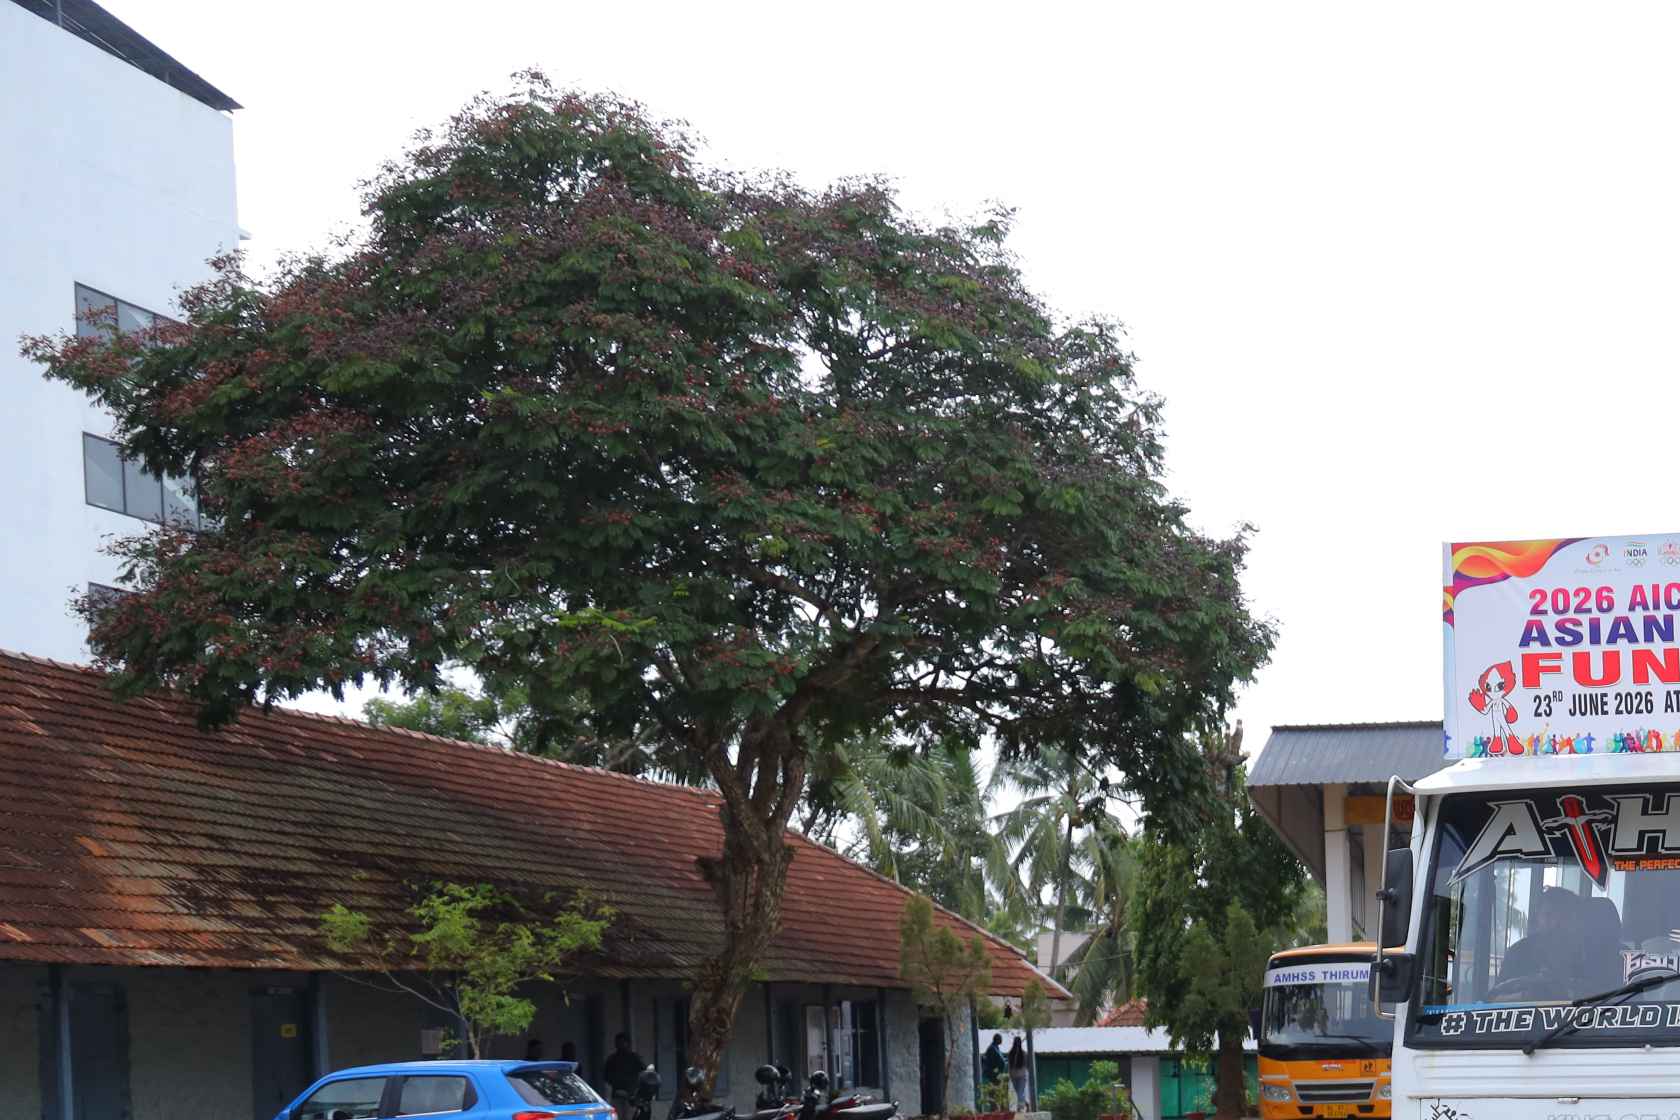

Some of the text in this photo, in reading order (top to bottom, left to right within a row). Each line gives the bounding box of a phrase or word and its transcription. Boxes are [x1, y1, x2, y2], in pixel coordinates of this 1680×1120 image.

[1528, 585, 1615, 615] 2026
[1518, 614, 1675, 647] ASIAN
[1568, 692, 1609, 717] JUNE
[1614, 691, 1654, 715] 2026
[1614, 860, 1635, 871] THE
[1274, 971, 1316, 984] AMHSS
[1472, 1008, 1537, 1033] THE
[1538, 1004, 1662, 1030] WORLD
